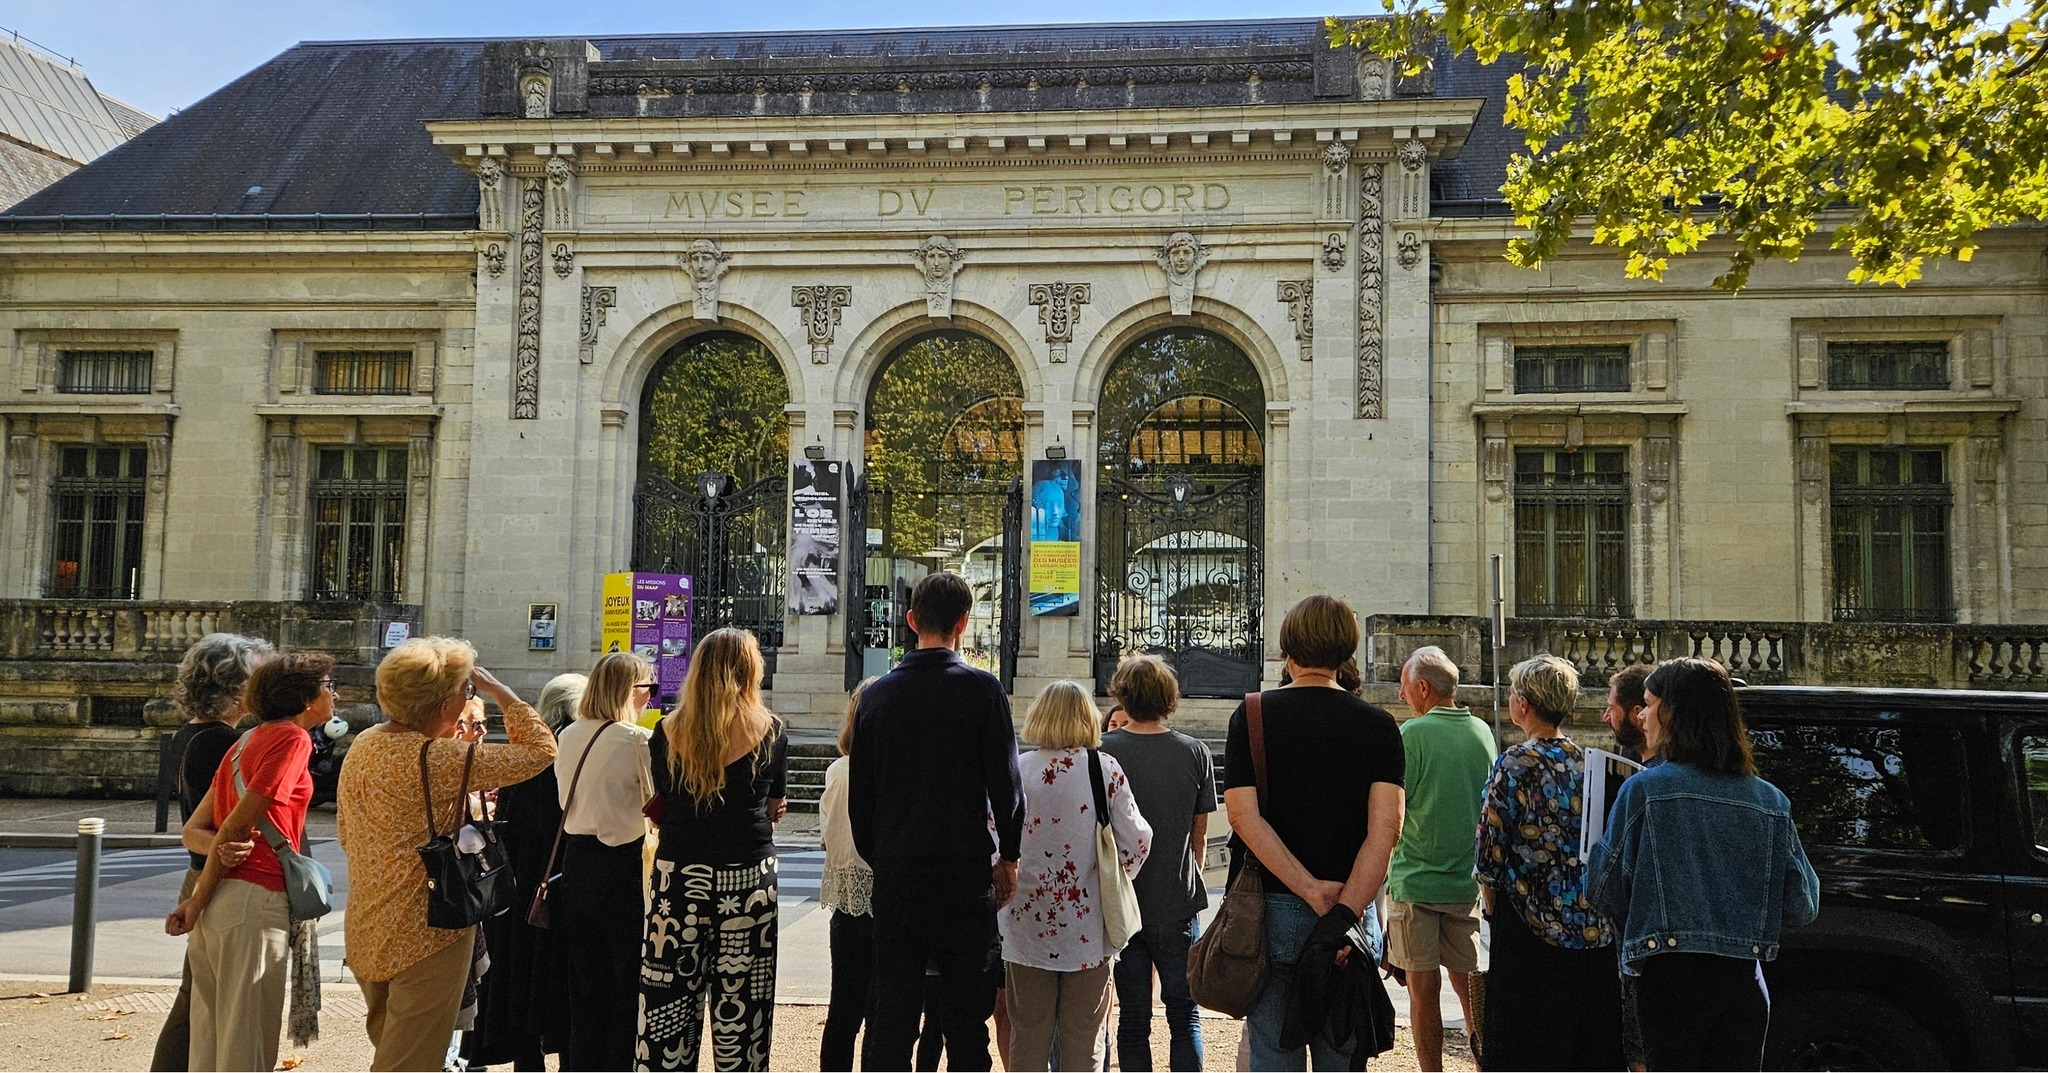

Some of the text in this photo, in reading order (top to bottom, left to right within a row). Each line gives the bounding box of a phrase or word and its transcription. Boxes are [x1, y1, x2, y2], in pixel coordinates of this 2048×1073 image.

[877, 188, 934, 217] DV
[1003, 182, 1232, 214] PERIGORD
[794, 508, 833, 518] L'OR
[794, 527, 837, 535] TEMPS
[605, 596, 630, 607] JOYEUX
